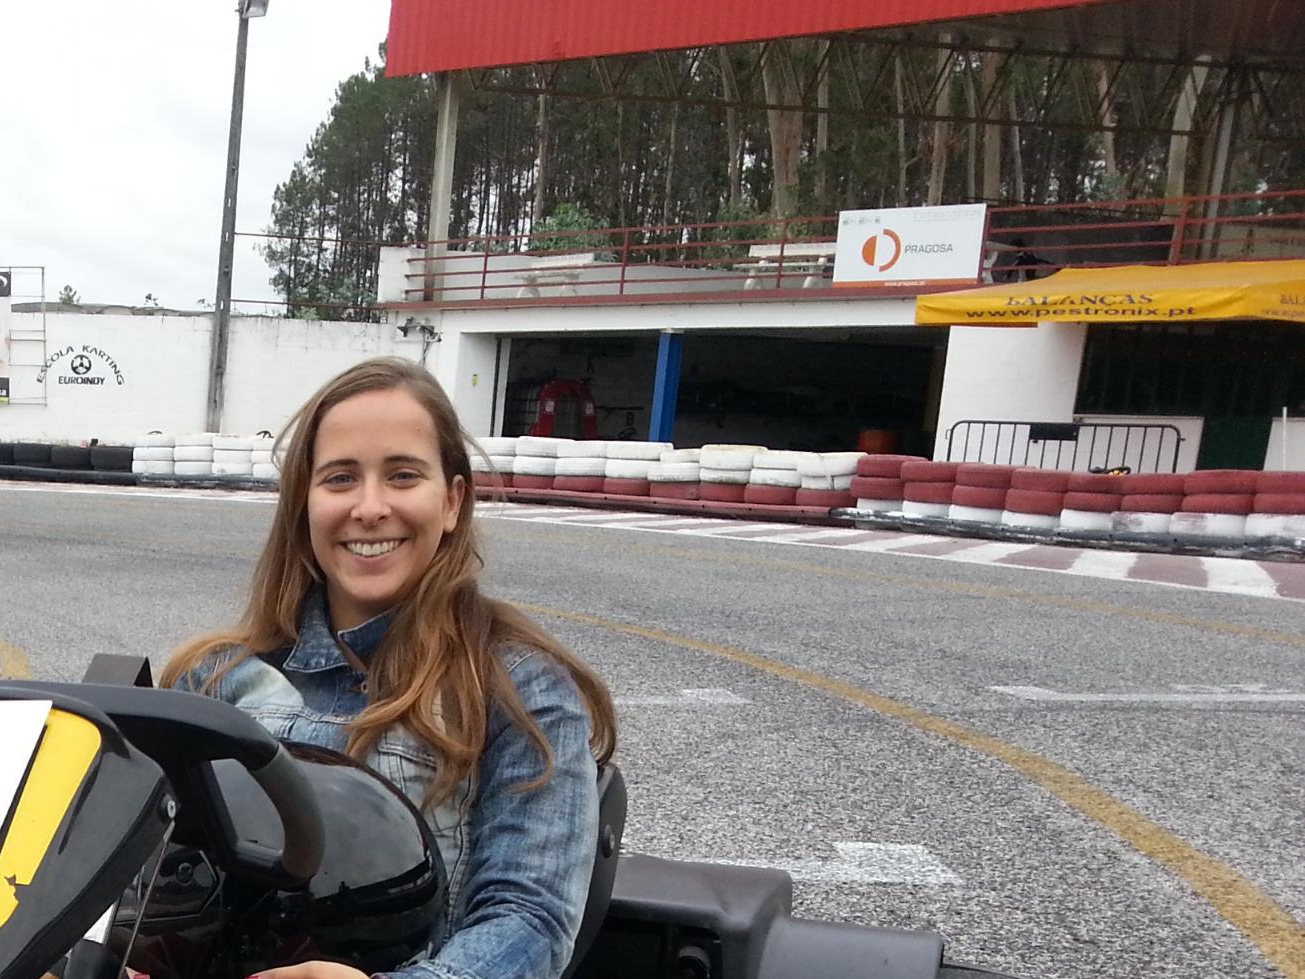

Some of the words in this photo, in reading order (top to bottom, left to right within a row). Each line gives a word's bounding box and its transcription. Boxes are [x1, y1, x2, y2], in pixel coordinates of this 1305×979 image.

[904, 243, 953, 254] PRAGOSA
[967, 306, 1196, 317] www.pestronix.pt
[36, 346, 74, 383] ESCOLA
[82, 345, 125, 385] KARTING
[58, 376, 105, 385] EUROINDY
